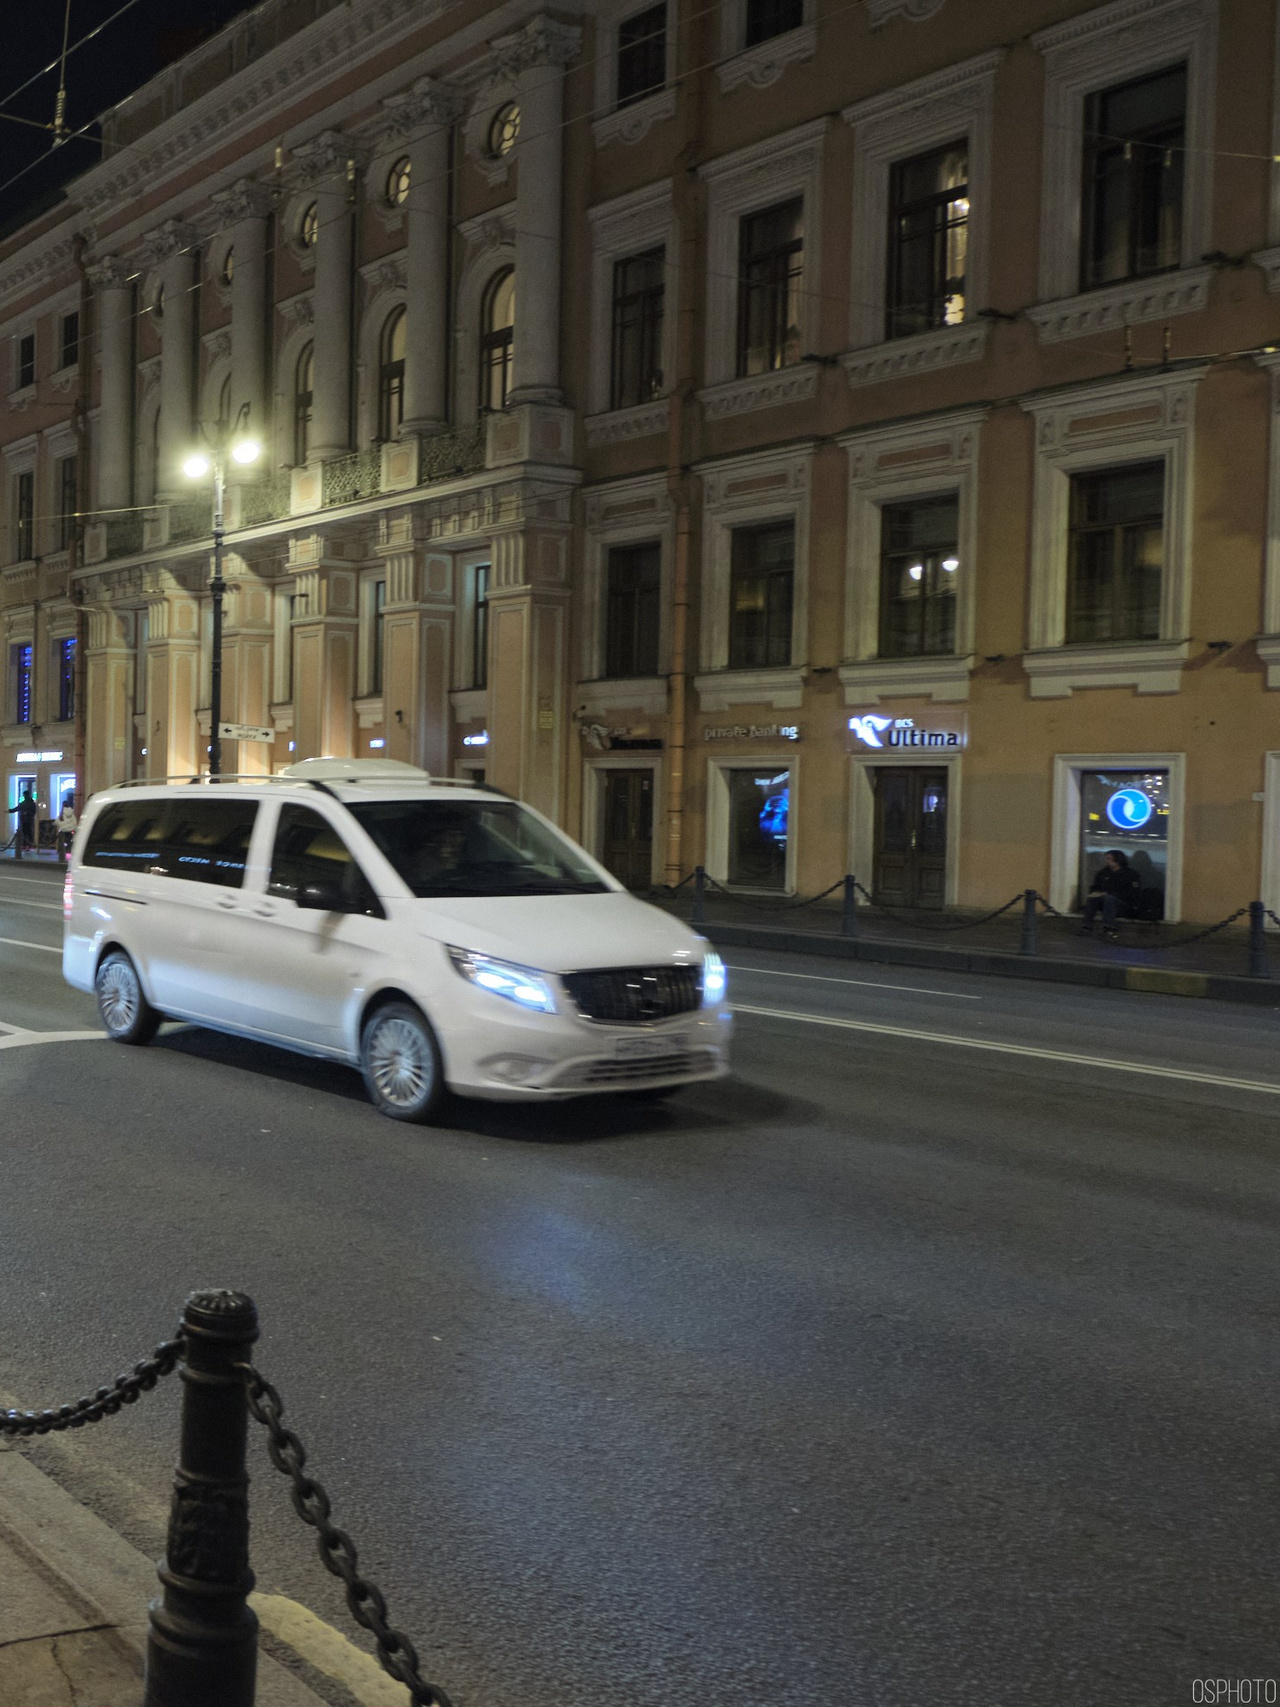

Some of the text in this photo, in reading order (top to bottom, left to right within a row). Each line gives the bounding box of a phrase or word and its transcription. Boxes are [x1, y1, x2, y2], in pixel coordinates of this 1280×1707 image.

[704, 724, 799, 742] private banking
[888, 729, 959, 746] Ultima
